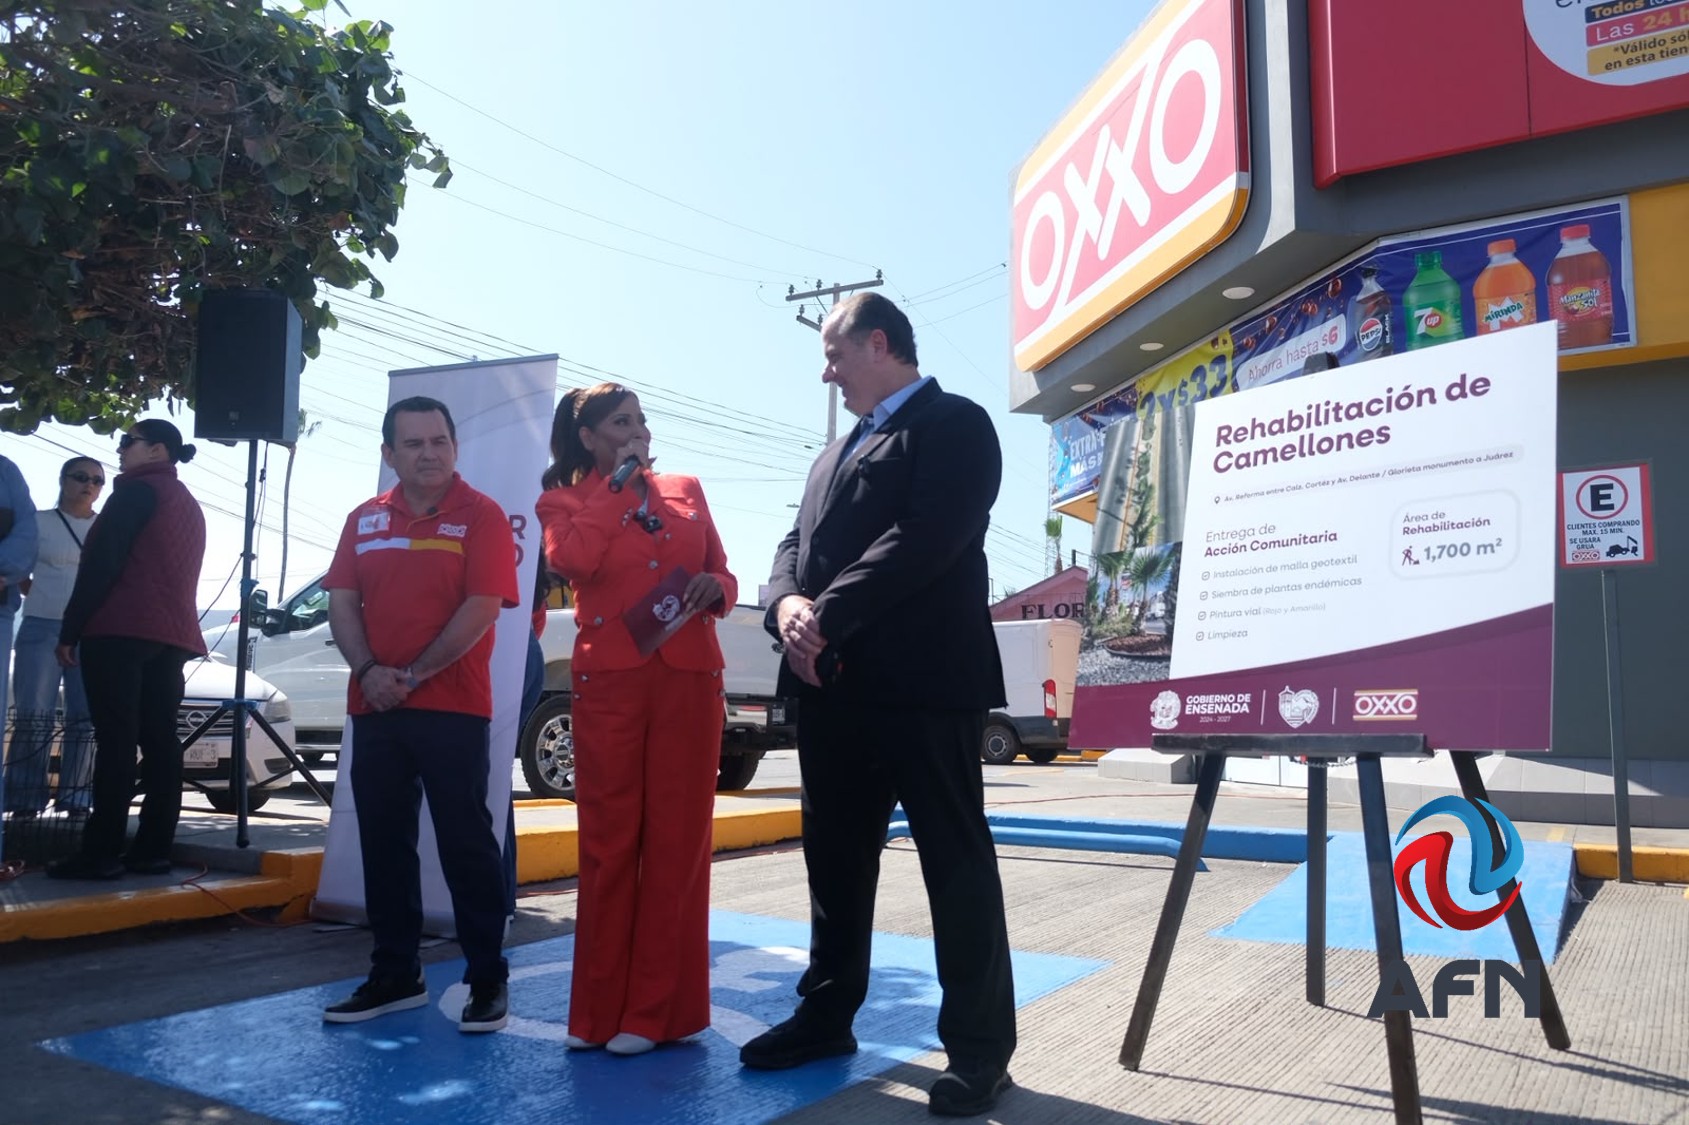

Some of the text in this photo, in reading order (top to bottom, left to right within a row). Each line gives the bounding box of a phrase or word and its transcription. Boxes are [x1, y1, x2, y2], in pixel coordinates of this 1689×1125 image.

[1591, 0, 1645, 19] Todos
[1596, 22, 1634, 42] Las
[1642, 11, 1673, 31] 24
[1605, 61, 1622, 71] en
[1625, 52, 1656, 66] esta
[1020, 38, 1222, 312] OXXO
[1248, 326, 1339, 381] Ahorra hasta $6
[1215, 373, 1491, 448] Rehabilitación de
[1213, 424, 1391, 474] Camellones
[1235, 491, 1265, 501] Reforma
[1266, 487, 1285, 496] entre
[1337, 476, 1348, 484] Av.
[1388, 465, 1422, 476] Glorieta
[1423, 458, 1474, 471] monumento
[1483, 451, 1514, 462] Juárez
[1590, 482, 1615, 512] E
[1403, 510, 1446, 524] Área de
[1403, 517, 1491, 536] Rehabilitación
[1567, 519, 1640, 531] CLIENTES COMPRANDO
[1206, 523, 1276, 543] Entrega de
[1204, 530, 1338, 558] Acción Comunitaria
[1424, 542, 1471, 563] 1,700
[1572, 551, 1600, 560] OXXO
[1213, 555, 1358, 579] Instalación de malla geotextil
[1211, 576, 1362, 599] Siembra de plantas endémicas
[1021, 603, 1085, 620] FLOR
[1209, 610, 1242, 620] Pintura
[1245, 607, 1262, 617] vial
[1207, 629, 1248, 641] Limpieza
[1186, 693, 1252, 704] GOBIERNO DE
[1355, 694, 1417, 716] OXXO
[1185, 703, 1250, 715] ENSENADA
